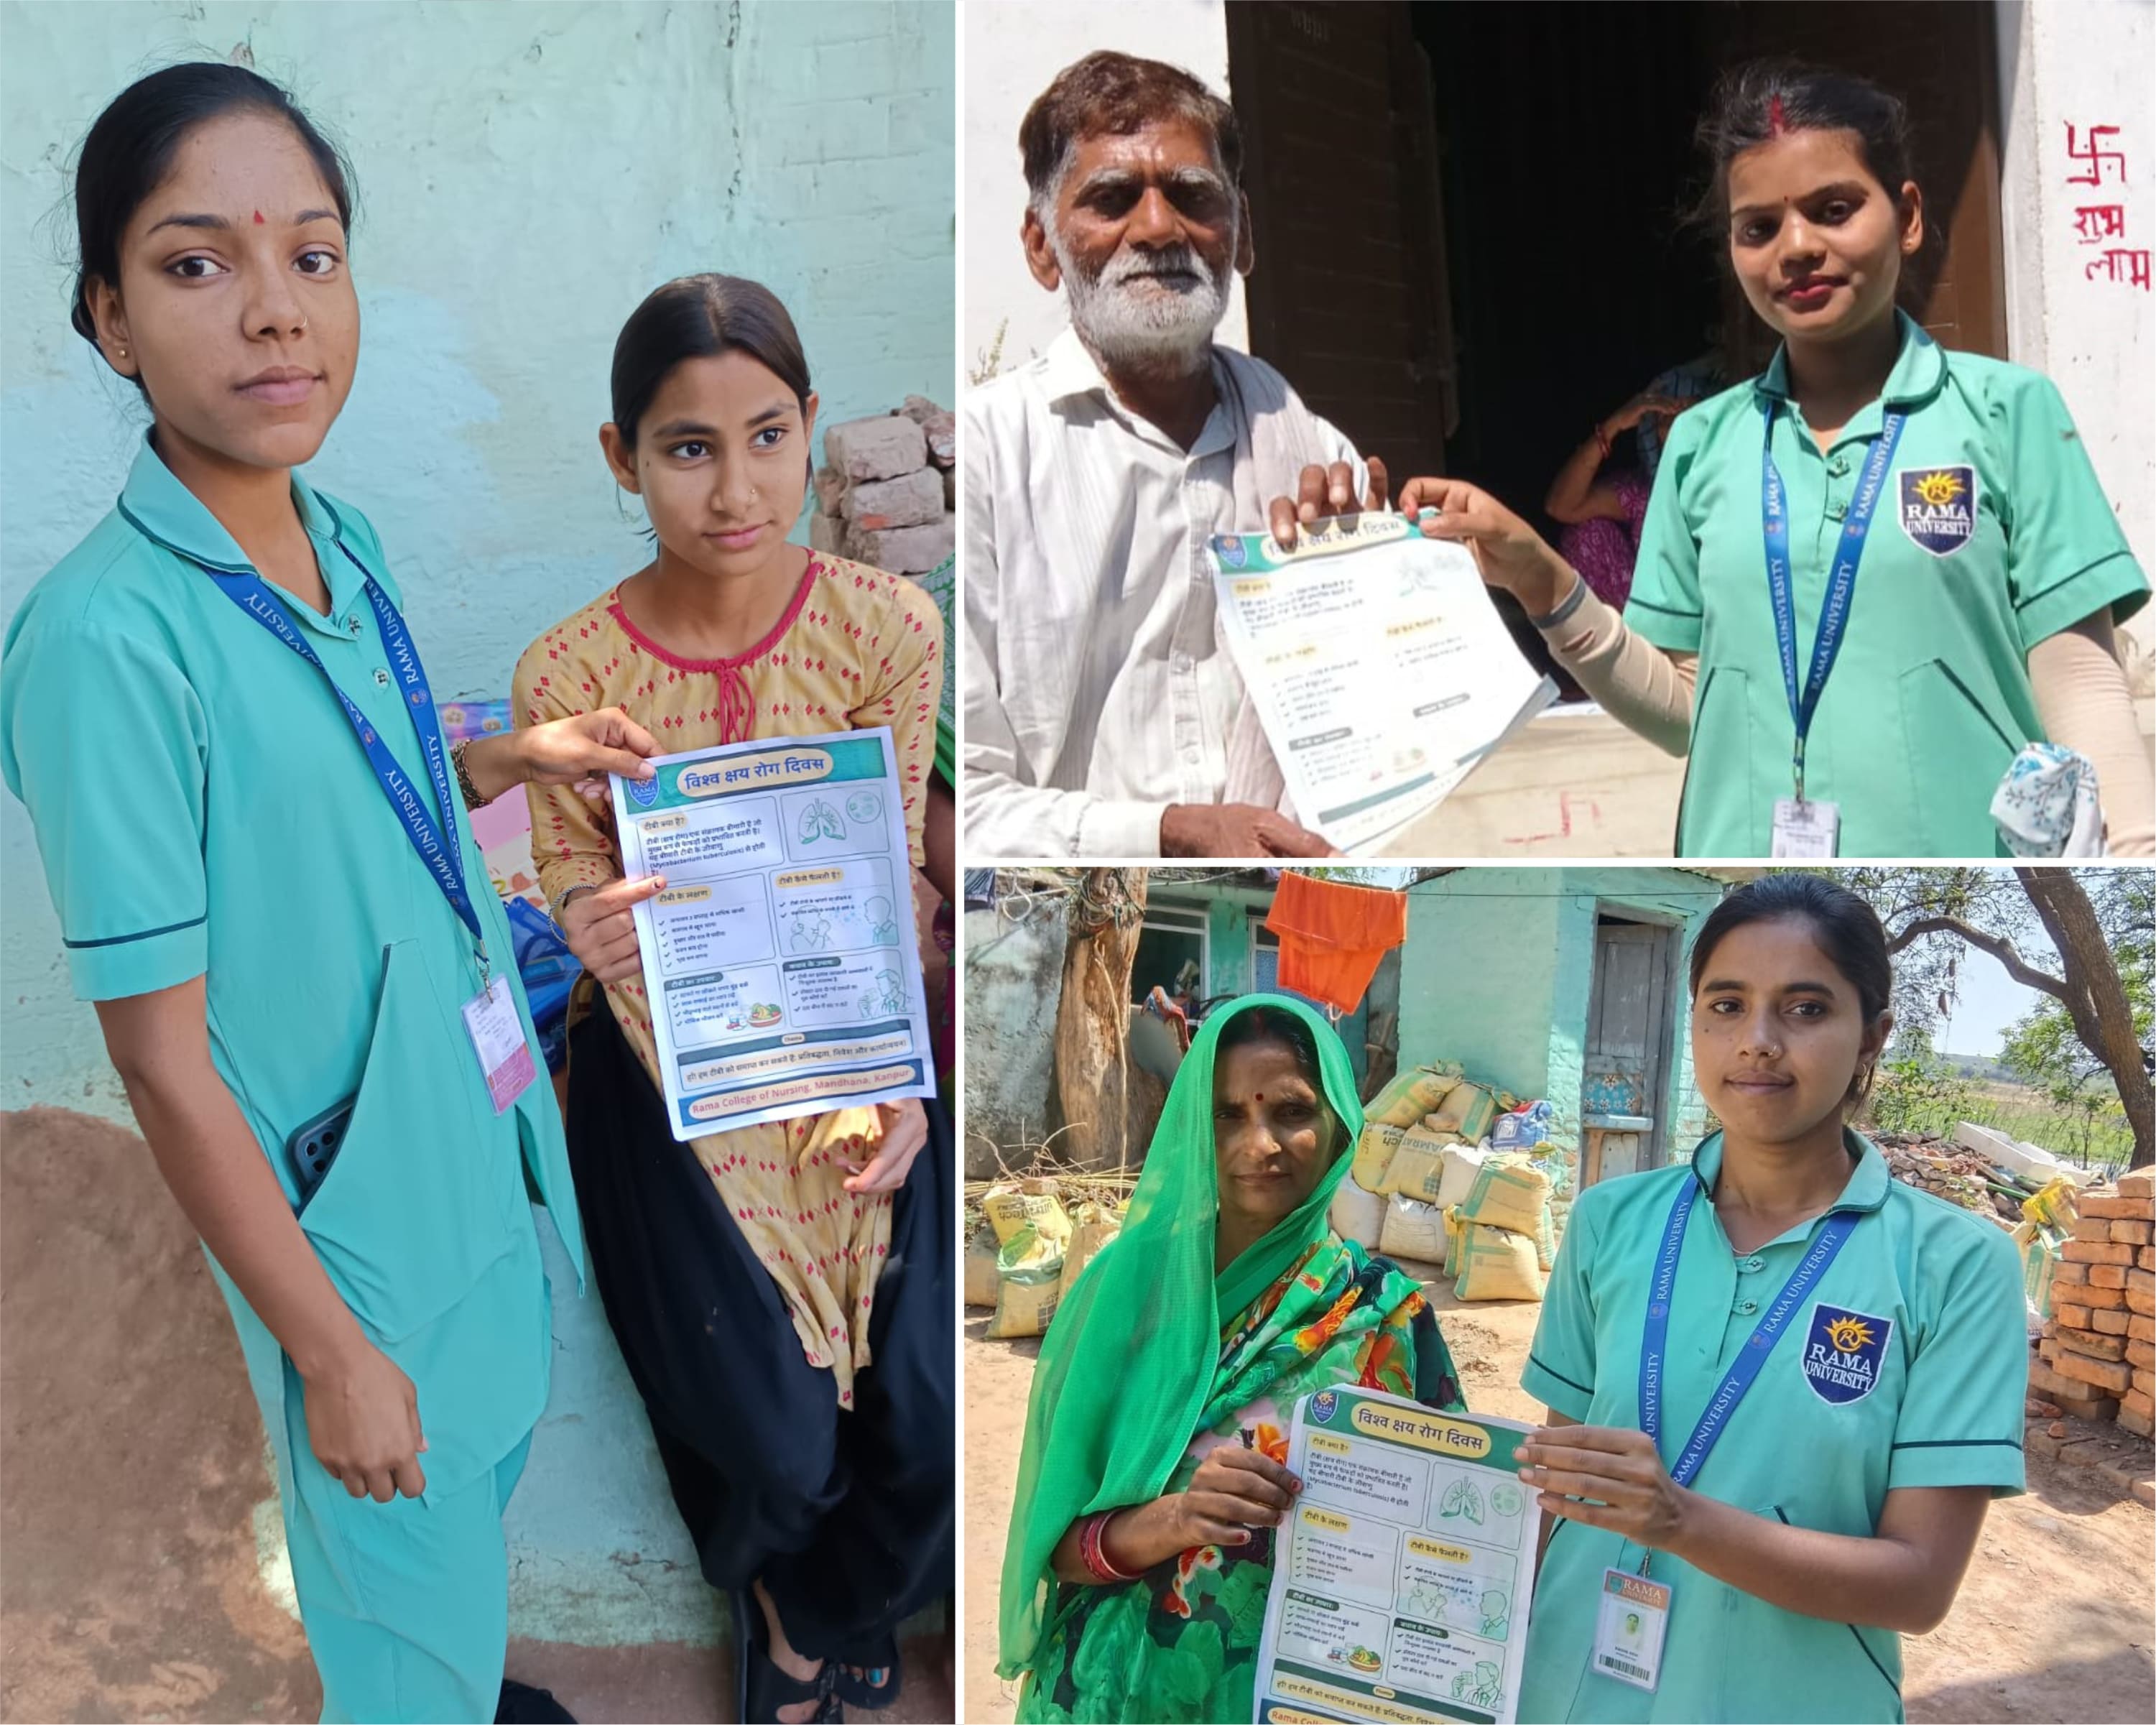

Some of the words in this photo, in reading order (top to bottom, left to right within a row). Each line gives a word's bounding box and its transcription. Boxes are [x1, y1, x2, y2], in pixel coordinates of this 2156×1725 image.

[1768, 479, 1781, 516] RAMA
[1856, 478, 1877, 519] RAMA
[1906, 504, 1970, 521] RAMA
[1905, 519, 1971, 536] UNIVERSITY
[1770, 558, 1788, 643] UNIVERSITY
[1820, 560, 1854, 647] UNIVERSITY
[393, 637, 420, 685] RAMA
[1810, 648, 1831, 691] RAMA
[426, 734, 454, 831] UNIVERSITY
[684, 770, 721, 790] विश्व
[725, 766, 750, 783] क्षय
[754, 761, 781, 780] रोग
[784, 757, 825, 776] दिवस
[384, 769, 439, 856] UNIVERSITY
[432, 854, 458, 890] RAMA
[691, 1102, 720, 1114] Rama
[722, 1093, 757, 1109] College
[759, 1091, 771, 1101] of
[874, 1068, 911, 1084] Kanpur
[1664, 1201, 1689, 1264] UNIVERSITY
[1657, 1264, 1674, 1300] RAMA
[1766, 1298, 1792, 1333] RAMA
[1787, 1231, 1838, 1299] UNIVERSITY
[1805, 1359, 1874, 1392] UNIVERSITY
[1808, 1343, 1874, 1375] RAMA
[1646, 1351, 1660, 1433] UNIVERSITY
[1358, 1409, 1389, 1429] विश्व
[1392, 1420, 1415, 1435] क्षय
[1419, 1423, 1443, 1442] रोग
[1445, 1429, 1484, 1451] दिवस
[1693, 1376, 1741, 1451] UNIVERSITY
[1624, 1578, 1662, 1600] RAMA
[1271, 1710, 1298, 1724] Rama
